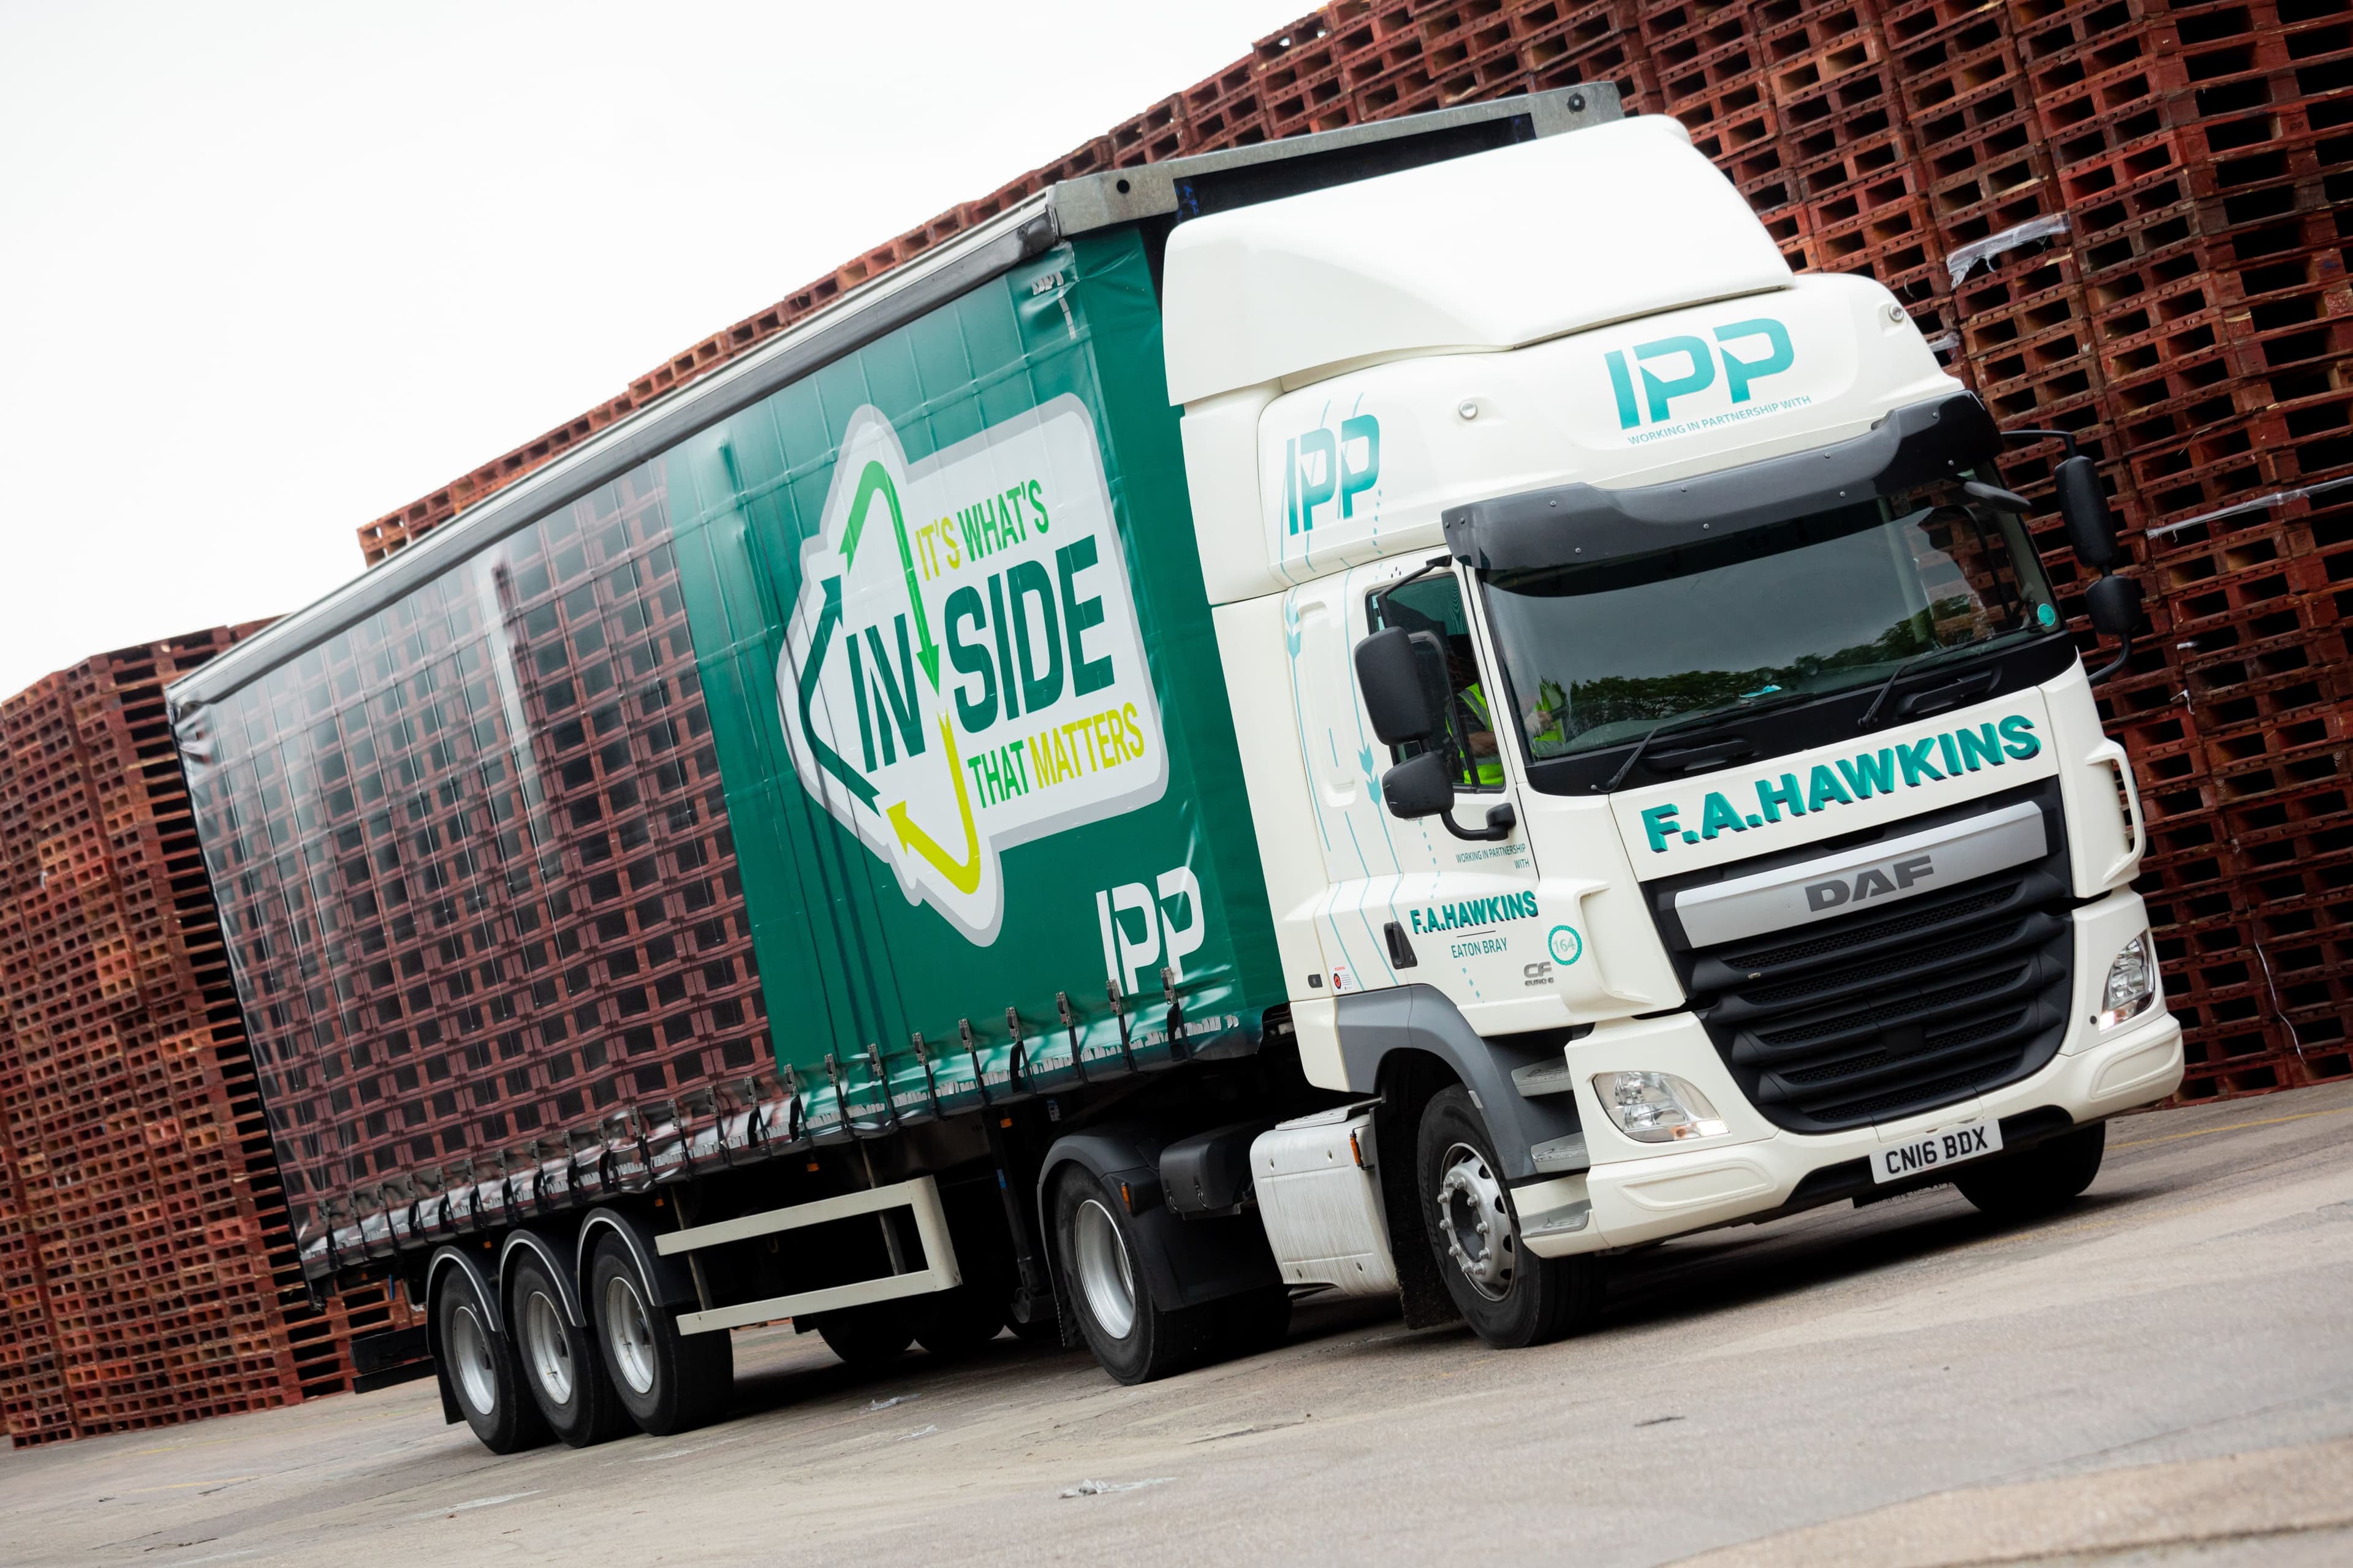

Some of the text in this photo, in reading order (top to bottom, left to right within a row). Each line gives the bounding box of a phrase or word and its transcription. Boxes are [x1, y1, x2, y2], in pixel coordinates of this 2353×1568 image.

[1604, 317, 1795, 430] IPP
[1627, 395, 1812, 445] WORKING IN PARTNERSHIP WITH
[1286, 414, 1380, 536] IPP
[915, 479, 1050, 581] IT'S WHAT'S
[967, 702, 1145, 809] THAT MATTERS
[1456, 843, 1526, 864] WORKING IN PARTNERSHIP
[1514, 858, 1530, 870] WITH
[1804, 854, 1935, 912] DAF
[1095, 865, 1205, 998] IPP
[1450, 937, 1509, 959] EATON BRAY
[1553, 937, 1576, 953] 164
[1523, 961, 1552, 979] CF
[1885, 1126, 1988, 1175] CN16 BDX
